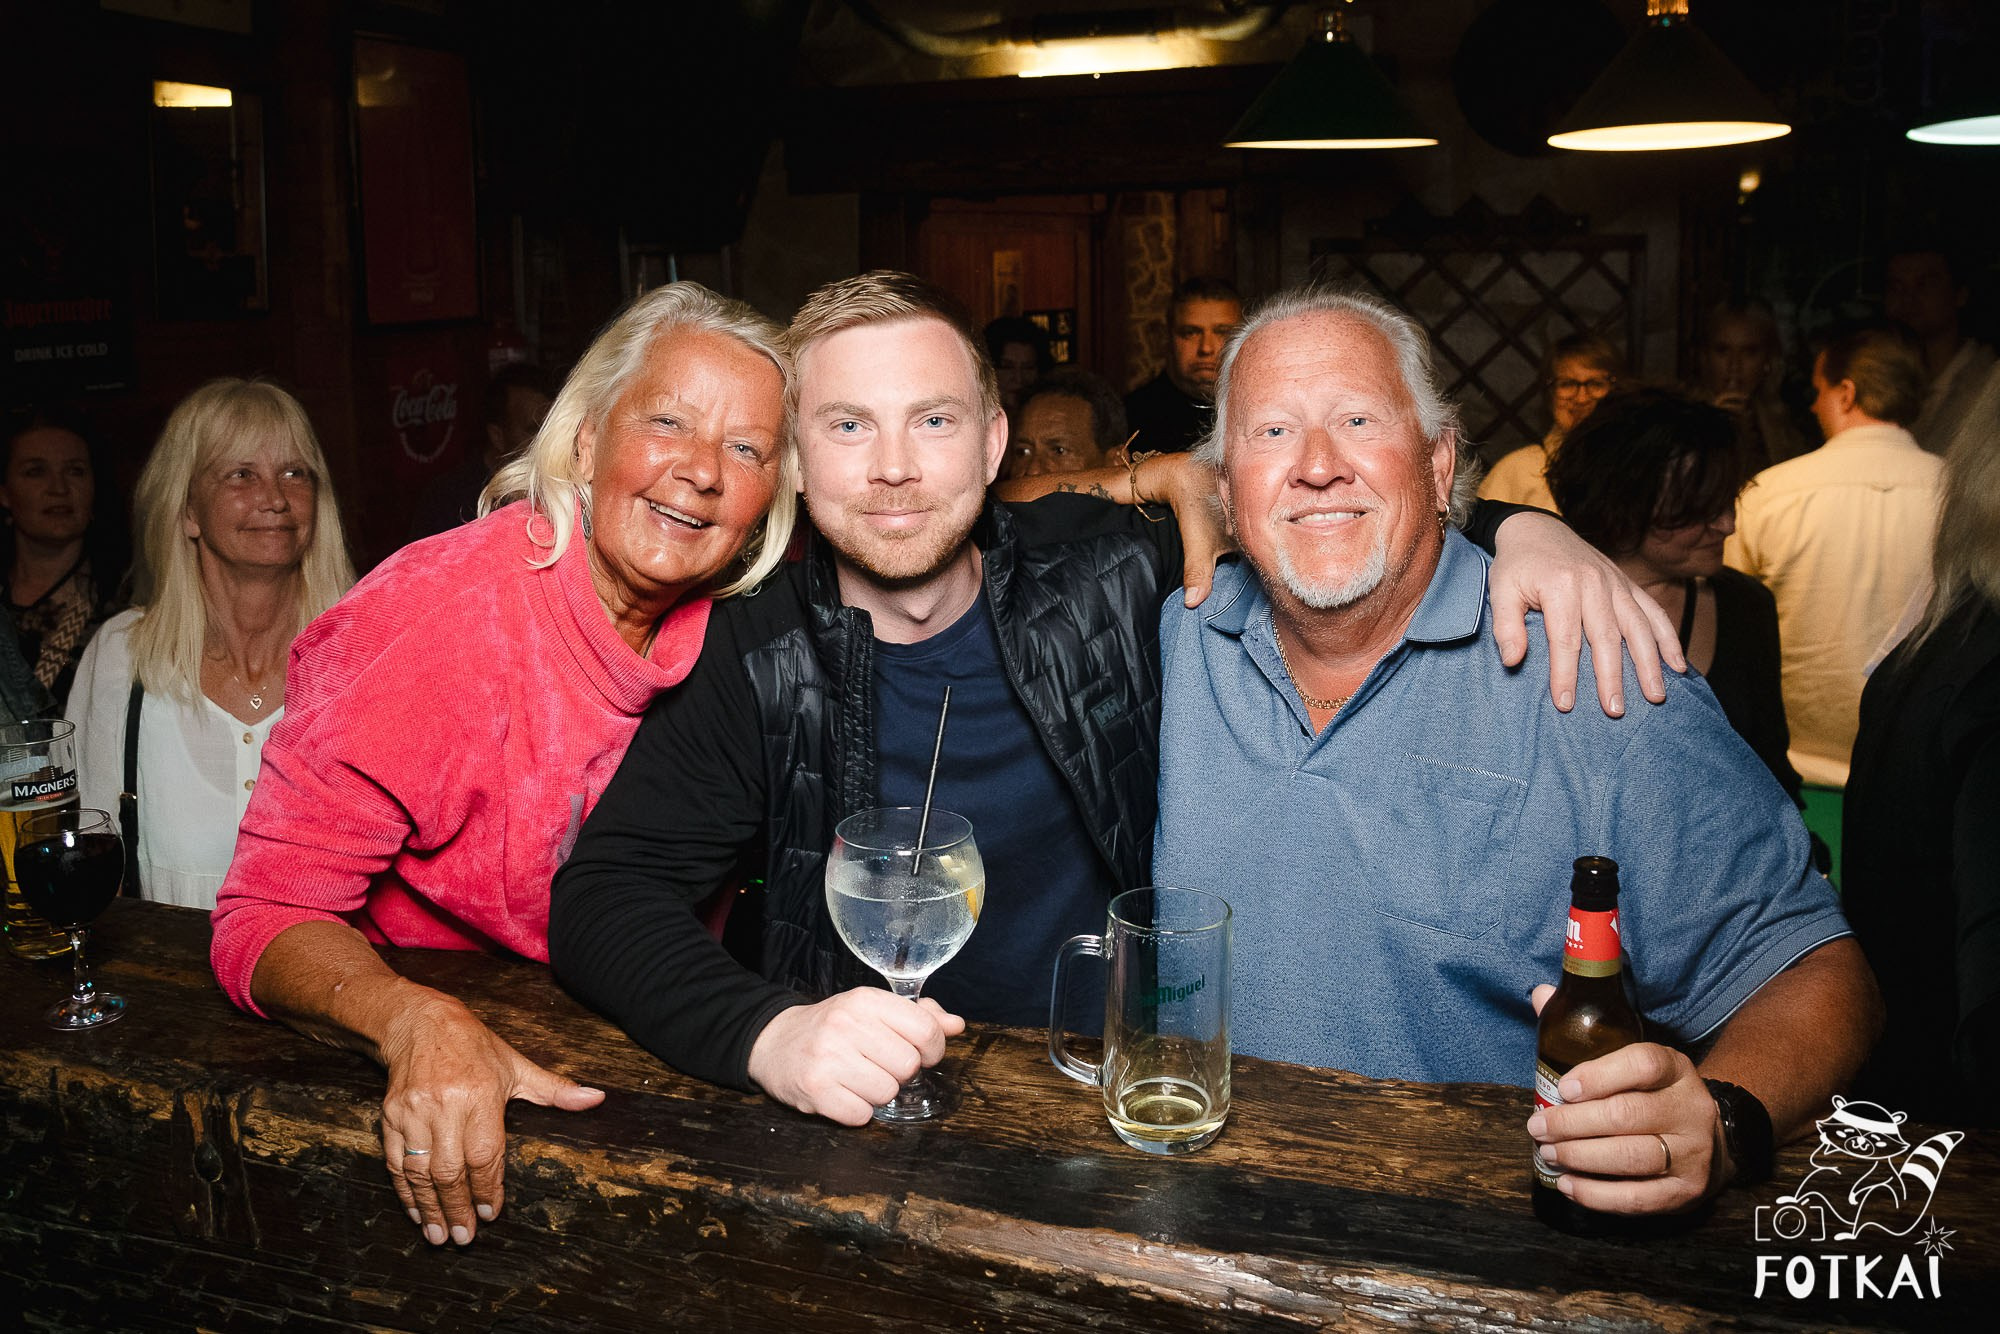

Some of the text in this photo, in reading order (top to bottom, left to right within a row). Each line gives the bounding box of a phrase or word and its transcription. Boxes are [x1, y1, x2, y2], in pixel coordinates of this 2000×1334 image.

[14, 342, 109, 363] DRINK ICE COLD
[14, 774, 76, 797] MAGNERS
[1156, 975, 1204, 1003] Miguel
